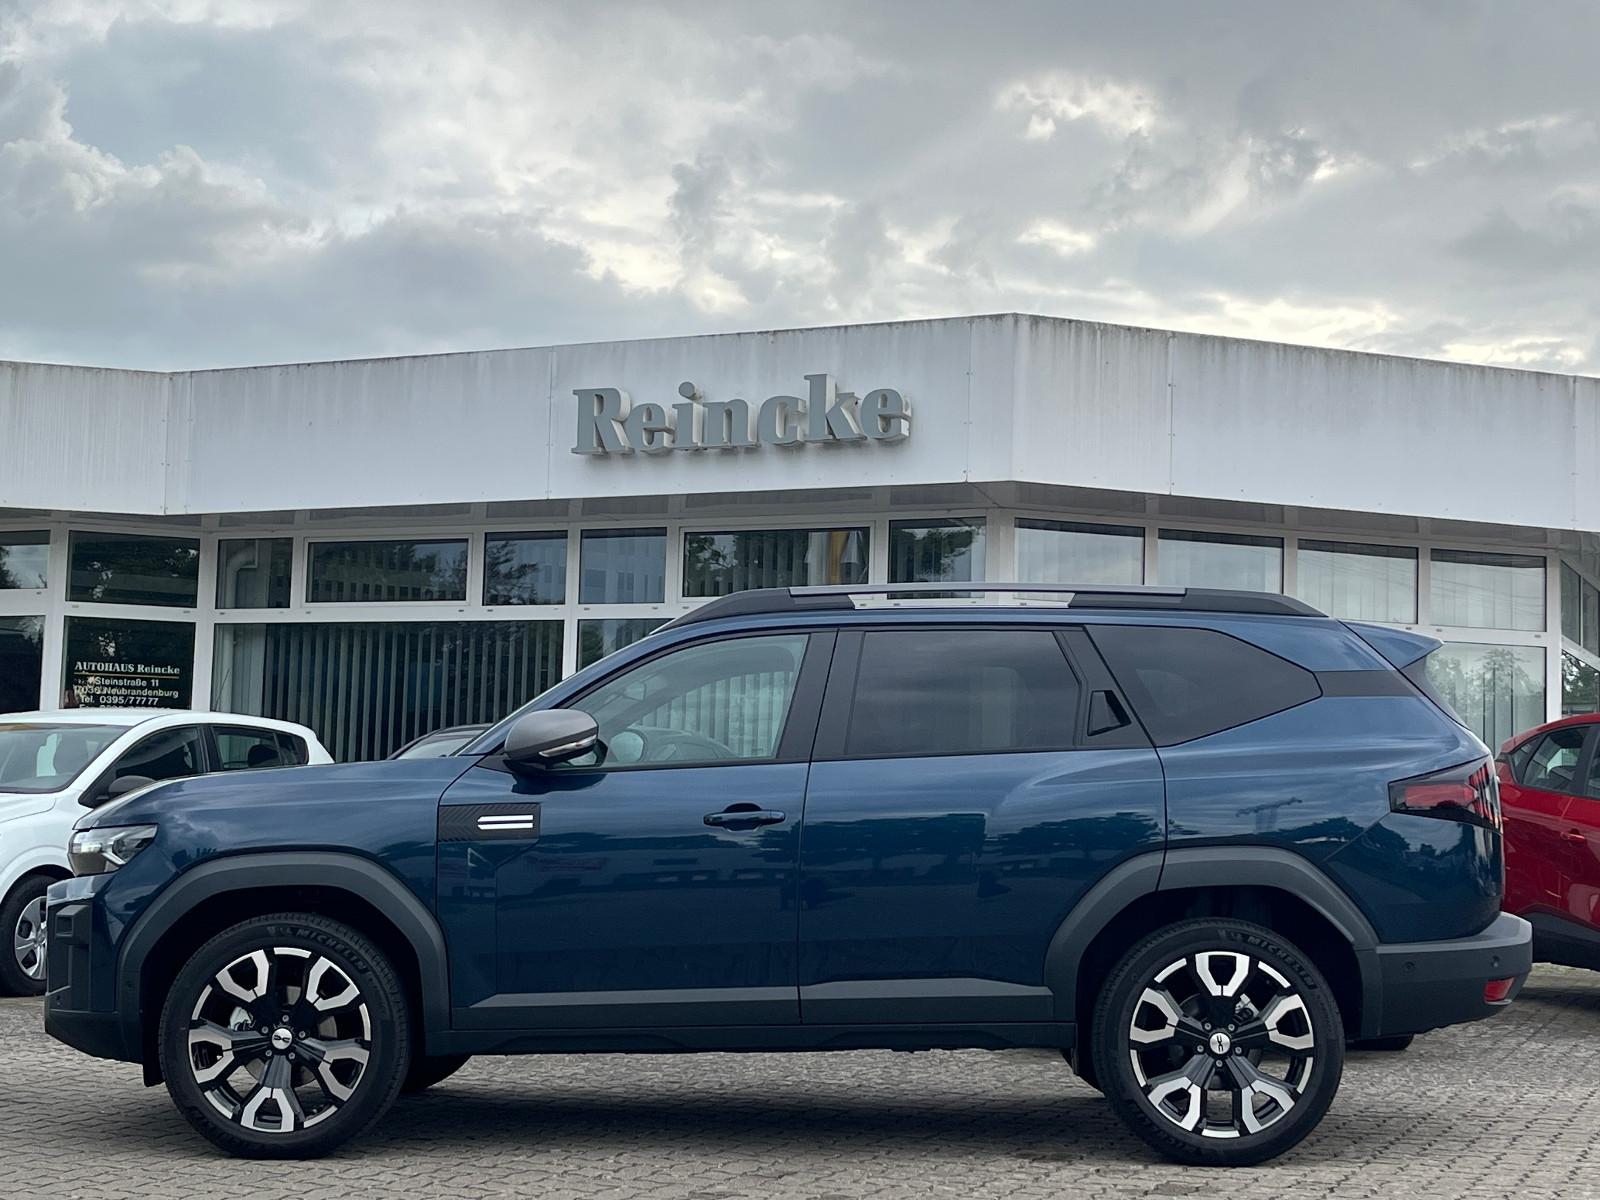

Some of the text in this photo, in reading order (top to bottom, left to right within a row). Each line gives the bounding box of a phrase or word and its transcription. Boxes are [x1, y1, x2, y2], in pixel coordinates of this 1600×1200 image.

[571, 373, 912, 455] Reincke
[74, 661, 180, 674] AUTOHAUS Reincke
[95, 676, 159, 687] Steinstraße 11
[103, 686, 179, 698] Neubrandenburg
